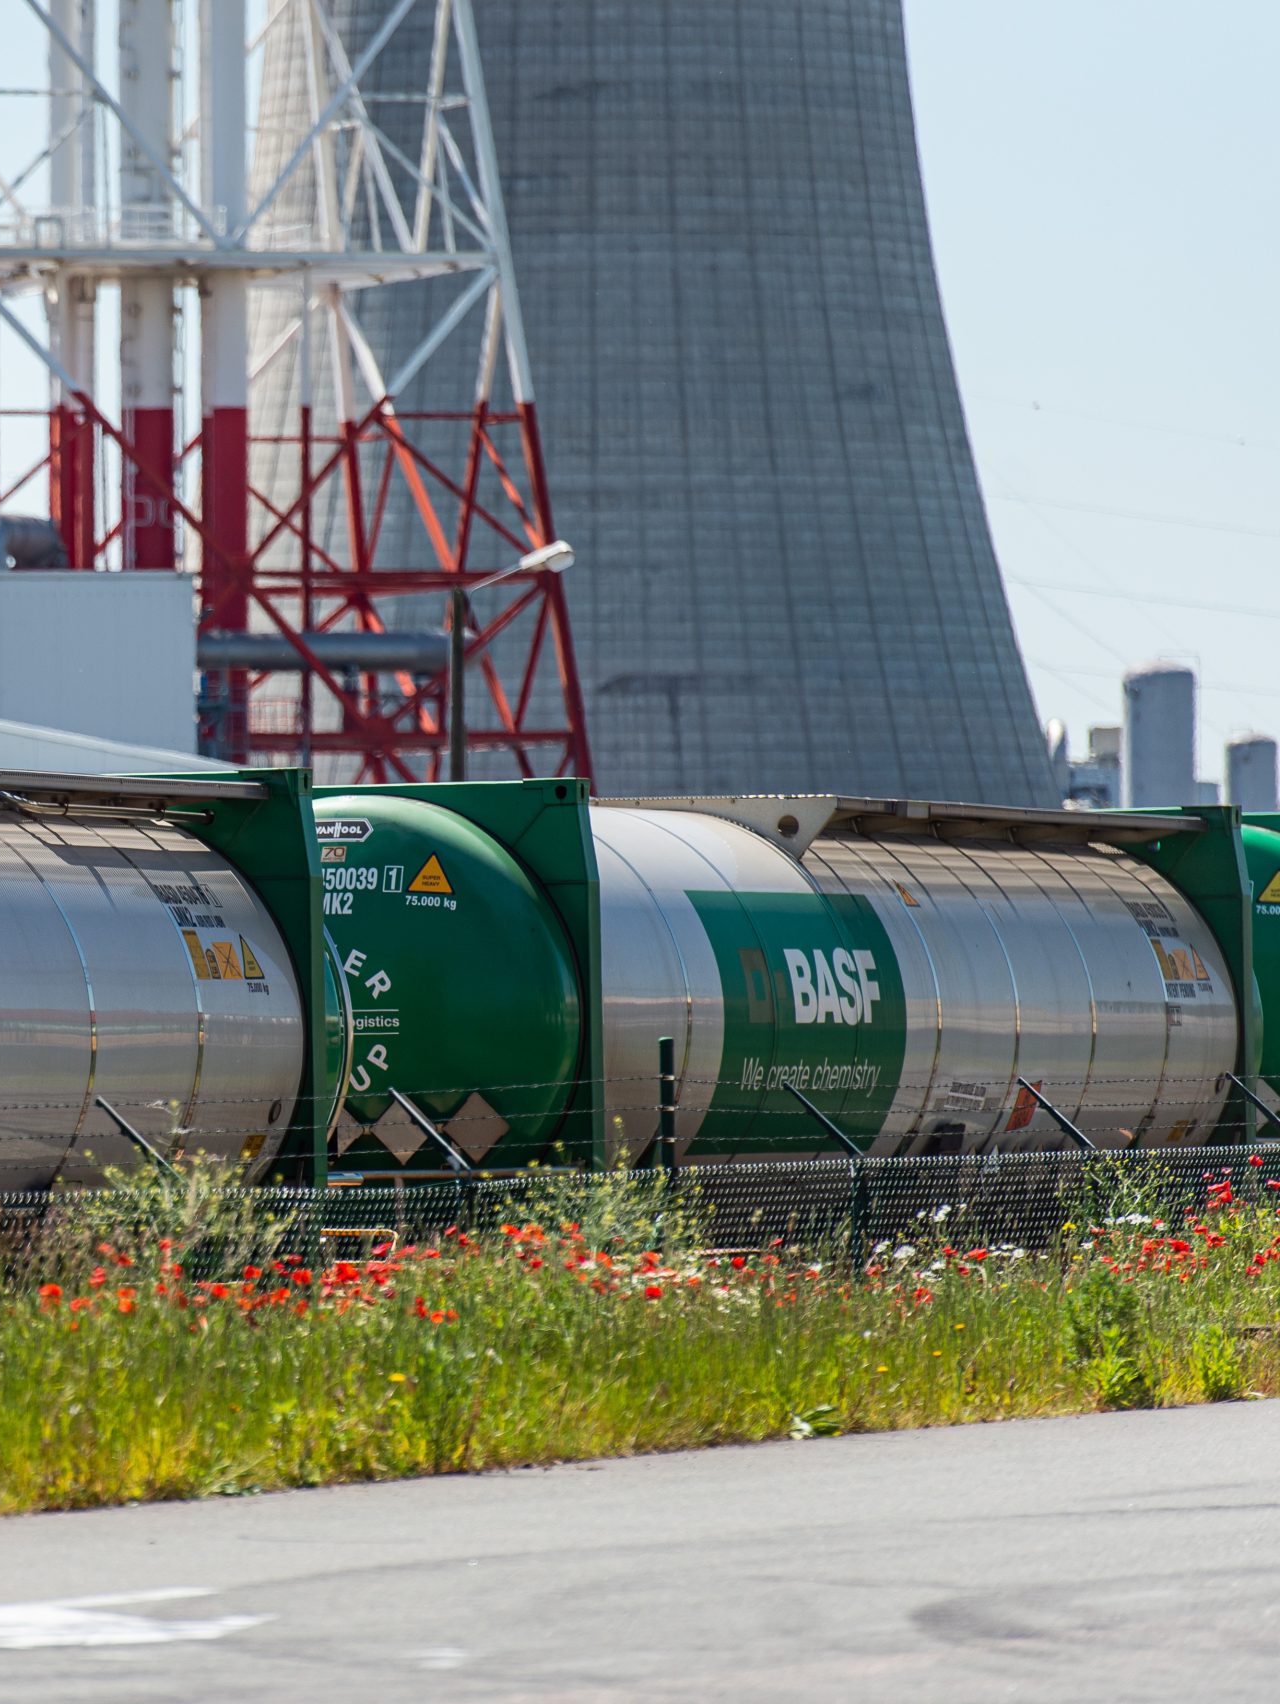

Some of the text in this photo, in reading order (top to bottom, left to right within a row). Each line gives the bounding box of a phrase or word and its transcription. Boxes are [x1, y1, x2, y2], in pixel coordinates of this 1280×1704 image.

[323, 847, 345, 858] 70
[388, 868, 398, 890] 1
[405, 895, 457, 910] 75.000 kg
[783, 947, 881, 1026] BASF
[740, 1057, 881, 1098] We create chemistry
